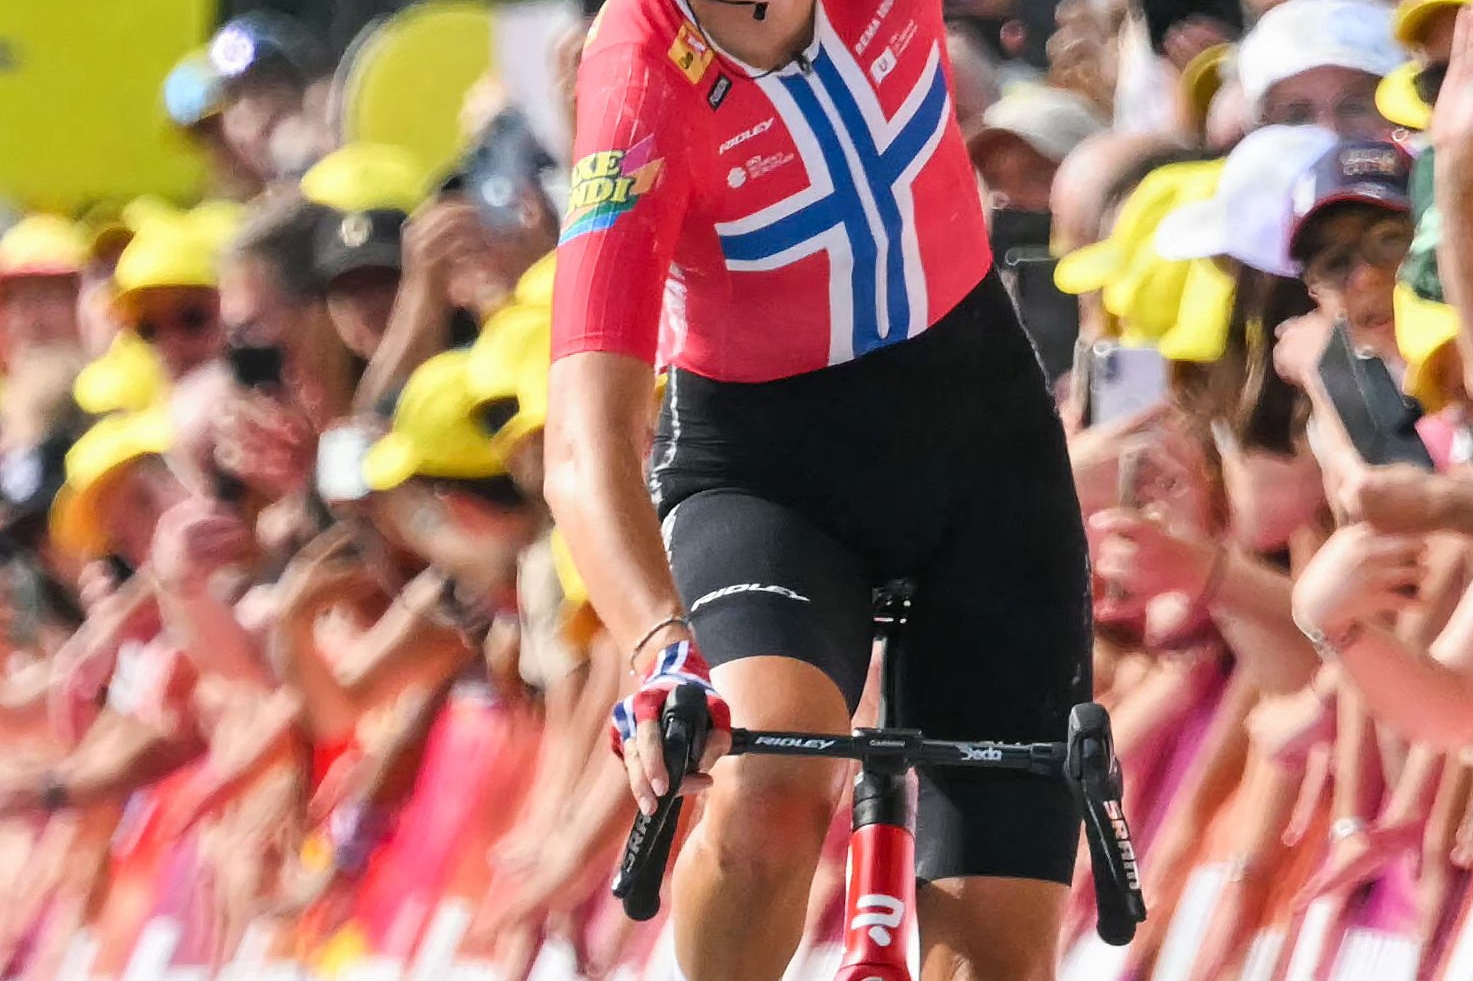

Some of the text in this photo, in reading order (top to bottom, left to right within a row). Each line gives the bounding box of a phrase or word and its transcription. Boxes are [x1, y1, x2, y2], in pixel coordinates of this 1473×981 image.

[719, 117, 775, 156] RIDLEY
[690, 582, 811, 612] RIDLEY
[754, 735, 837, 751] RIDLEY
[624, 812, 652, 874] SRA
[1103, 799, 1141, 890] SRAM
